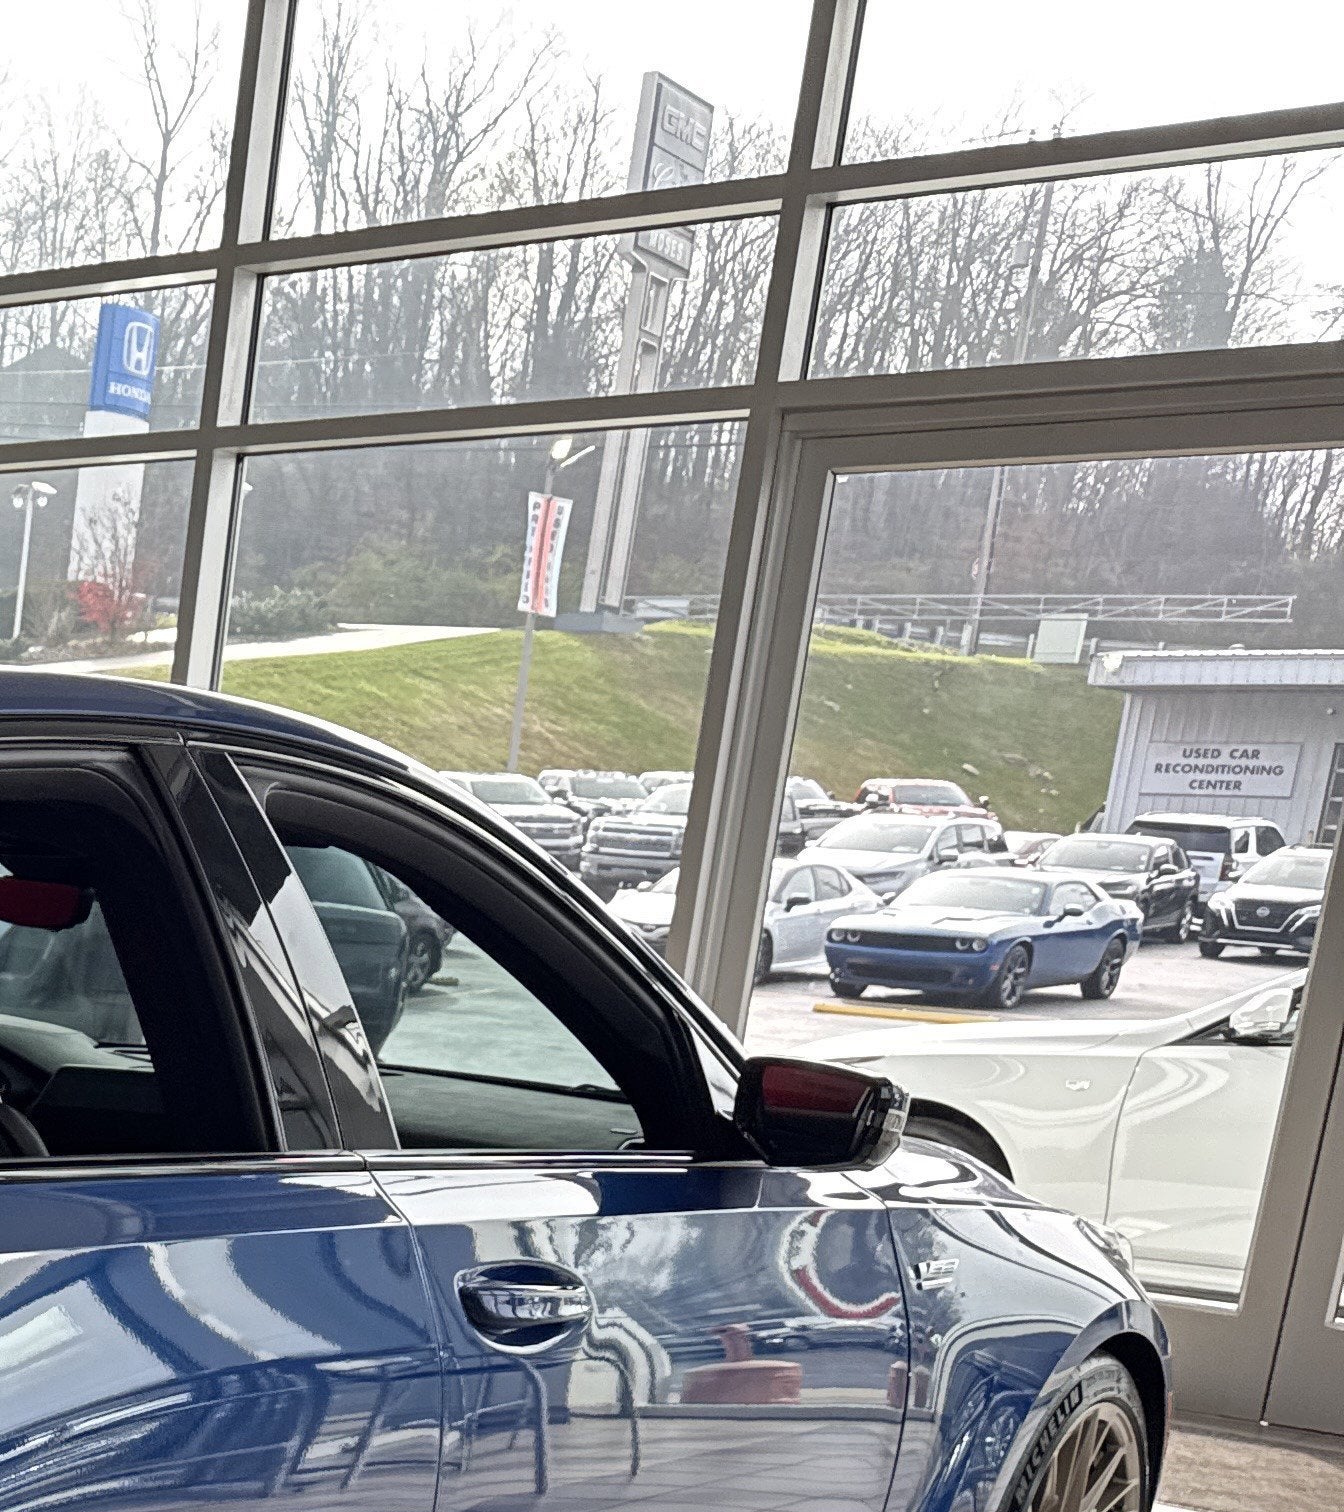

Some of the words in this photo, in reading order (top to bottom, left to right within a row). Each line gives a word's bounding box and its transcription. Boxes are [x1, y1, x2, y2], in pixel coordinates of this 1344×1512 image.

[662, 104, 708, 152] GMC
[1182, 748, 1222, 759] USED
[1229, 748, 1261, 760] CAR
[1154, 763, 1285, 777] RECONDITIONING
[1188, 779, 1243, 791] CENTER
[1012, 1381, 1083, 1507] MICHELIN
